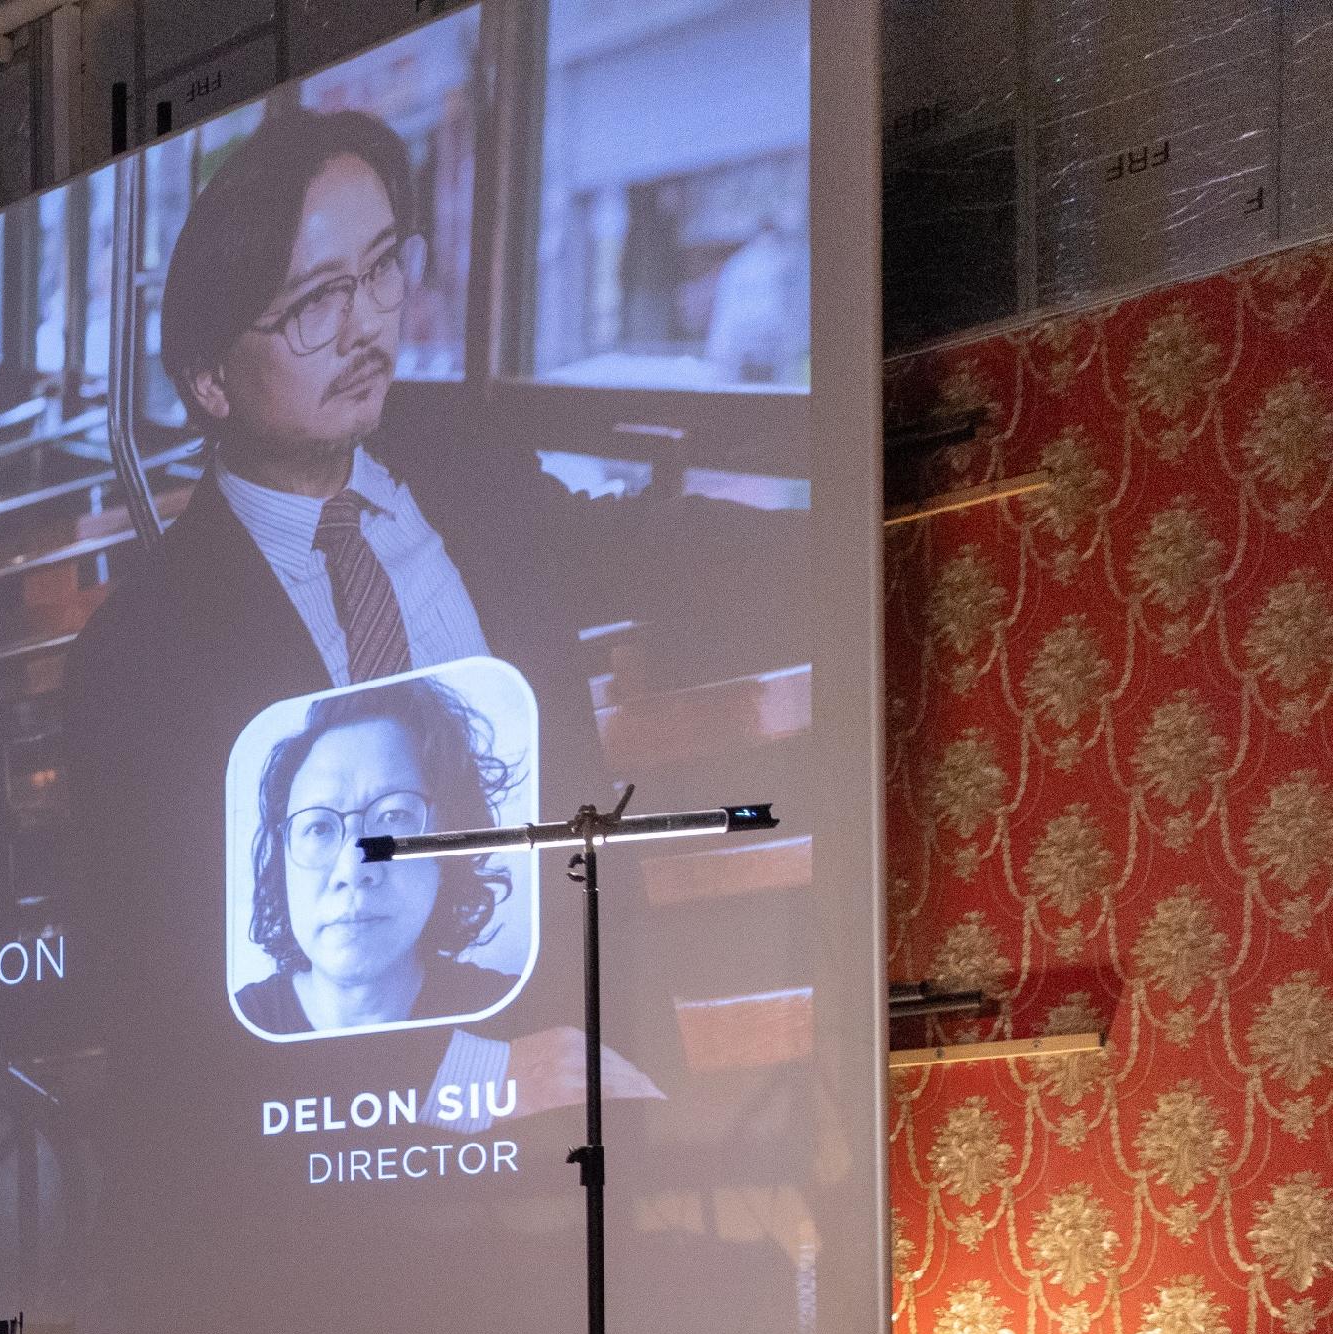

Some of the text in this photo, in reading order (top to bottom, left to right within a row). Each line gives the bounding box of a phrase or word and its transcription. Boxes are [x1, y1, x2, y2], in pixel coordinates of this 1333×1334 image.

[186, 70, 222, 103] FRF
[1104, 141, 1170, 184] FRF
[262, 1079, 517, 1136] DELON SIU
[308, 1140, 520, 1184] DIRECTOR
